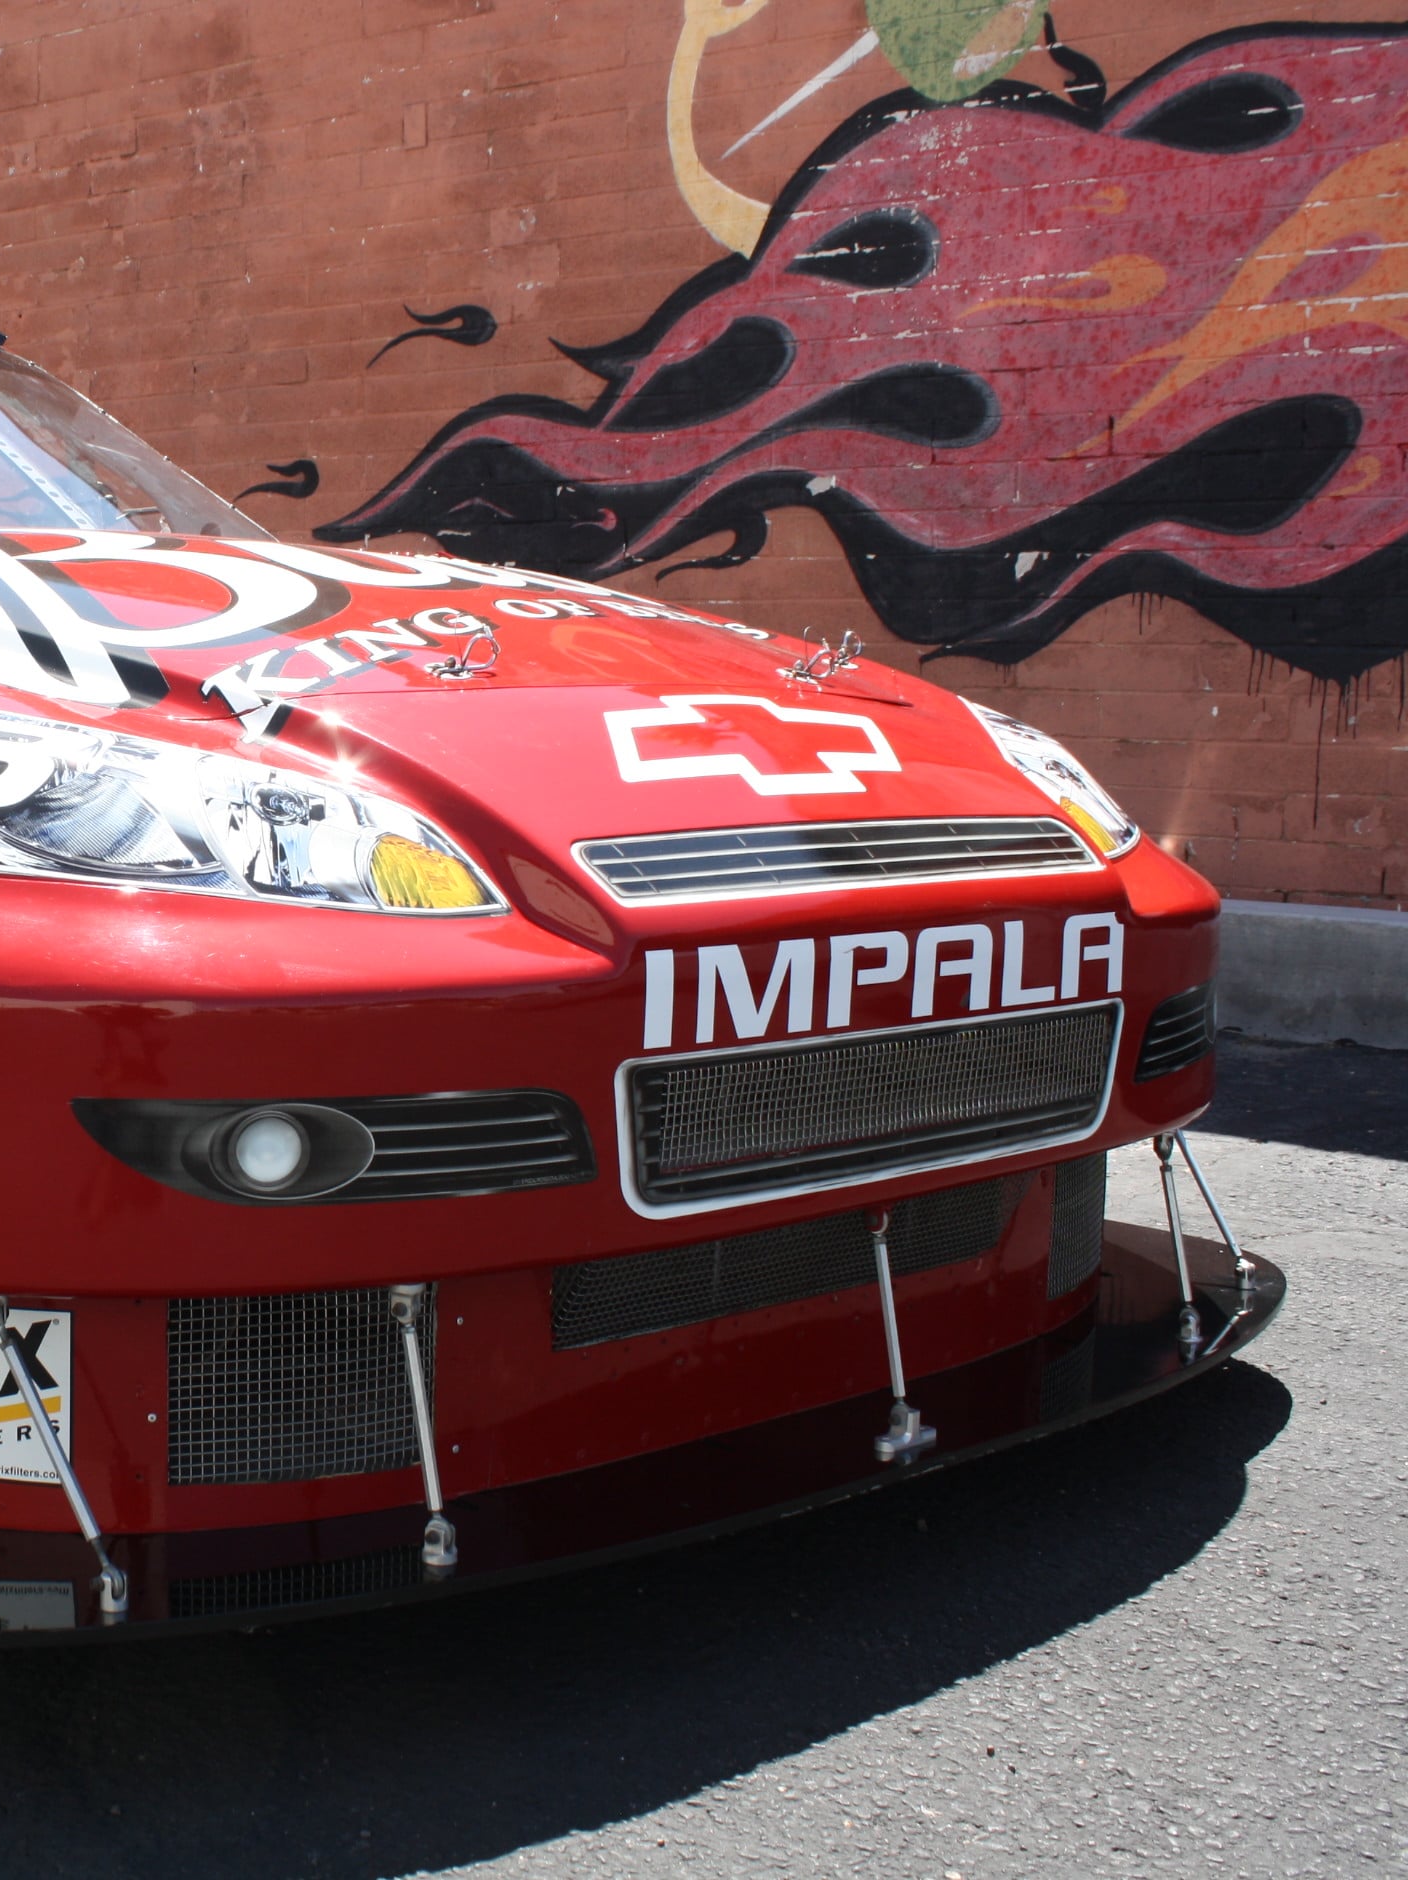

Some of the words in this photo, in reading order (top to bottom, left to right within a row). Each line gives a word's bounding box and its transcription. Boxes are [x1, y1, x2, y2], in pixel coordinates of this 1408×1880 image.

[201, 606, 487, 744] KING
[494, 598, 595, 620] OF
[642, 911, 1125, 1050] IMPALA
